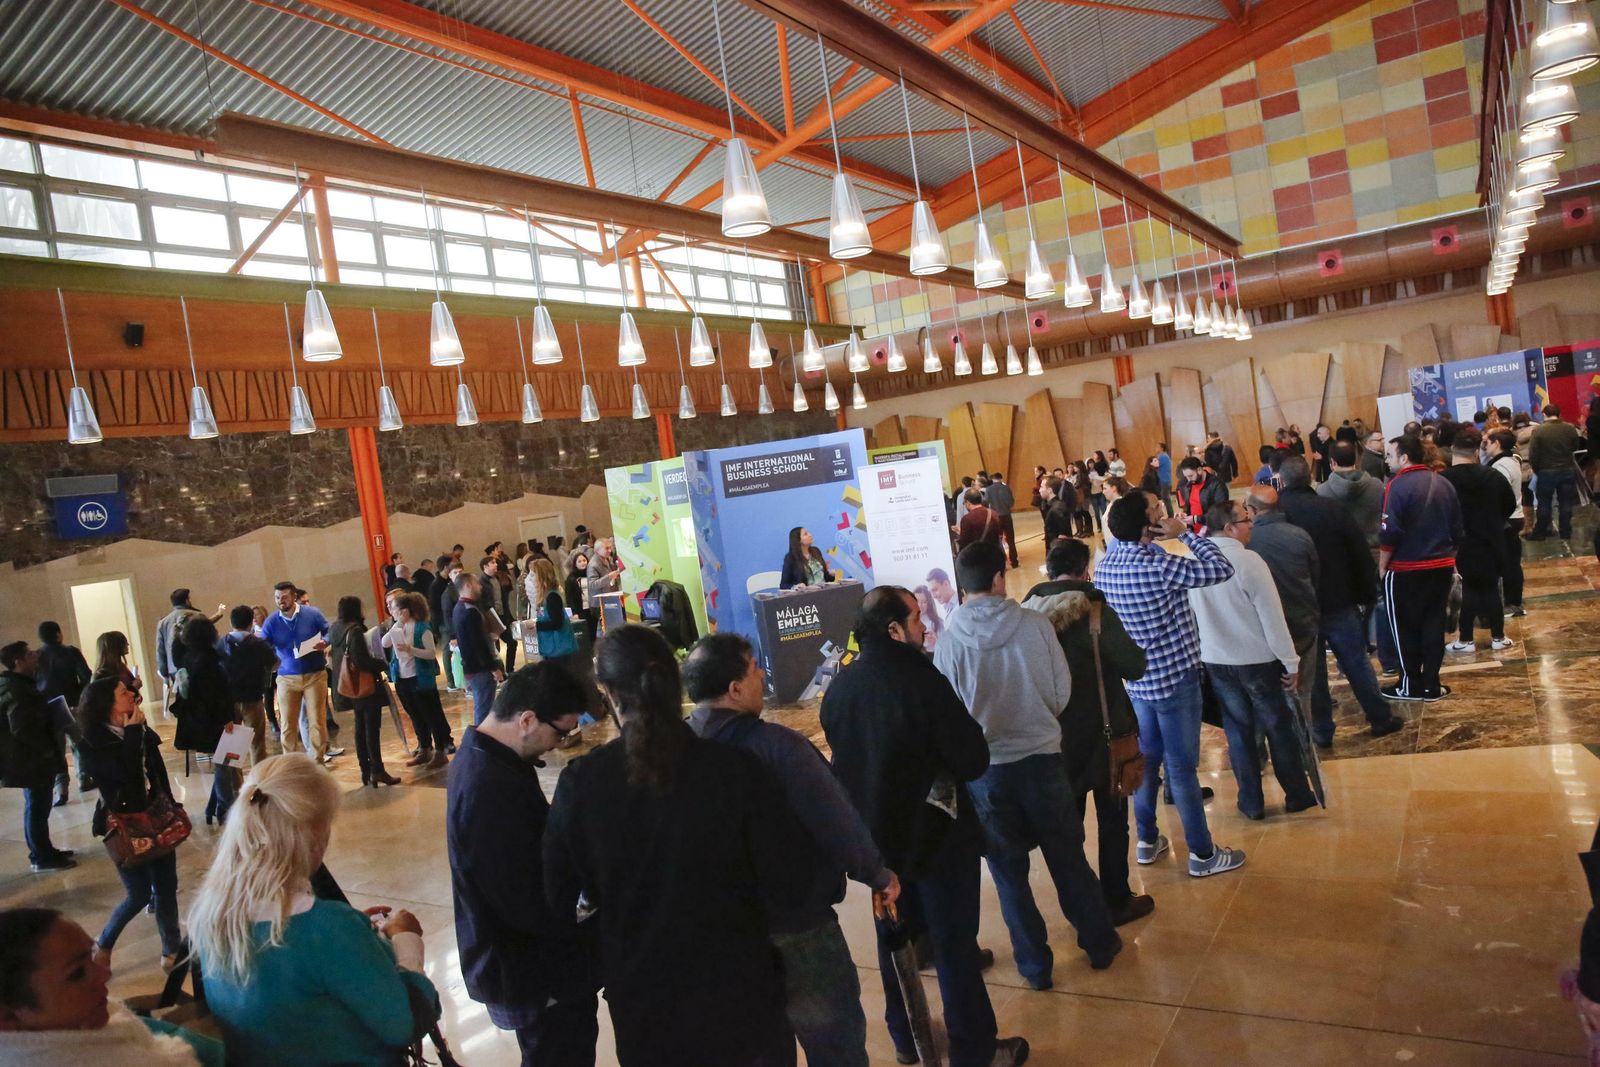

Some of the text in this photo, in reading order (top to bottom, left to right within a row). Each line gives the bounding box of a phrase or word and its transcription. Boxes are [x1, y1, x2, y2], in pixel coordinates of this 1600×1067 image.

[1454, 362, 1520, 380] LEROY MERLIN
[725, 463, 742, 473] IMF
[744, 452, 816, 470] INTERNATIONAL
[726, 462, 809, 481] BUSINESS SCHOOL
[776, 604, 819, 620] MÁLAGA
[777, 614, 820, 630] EMPLEA
